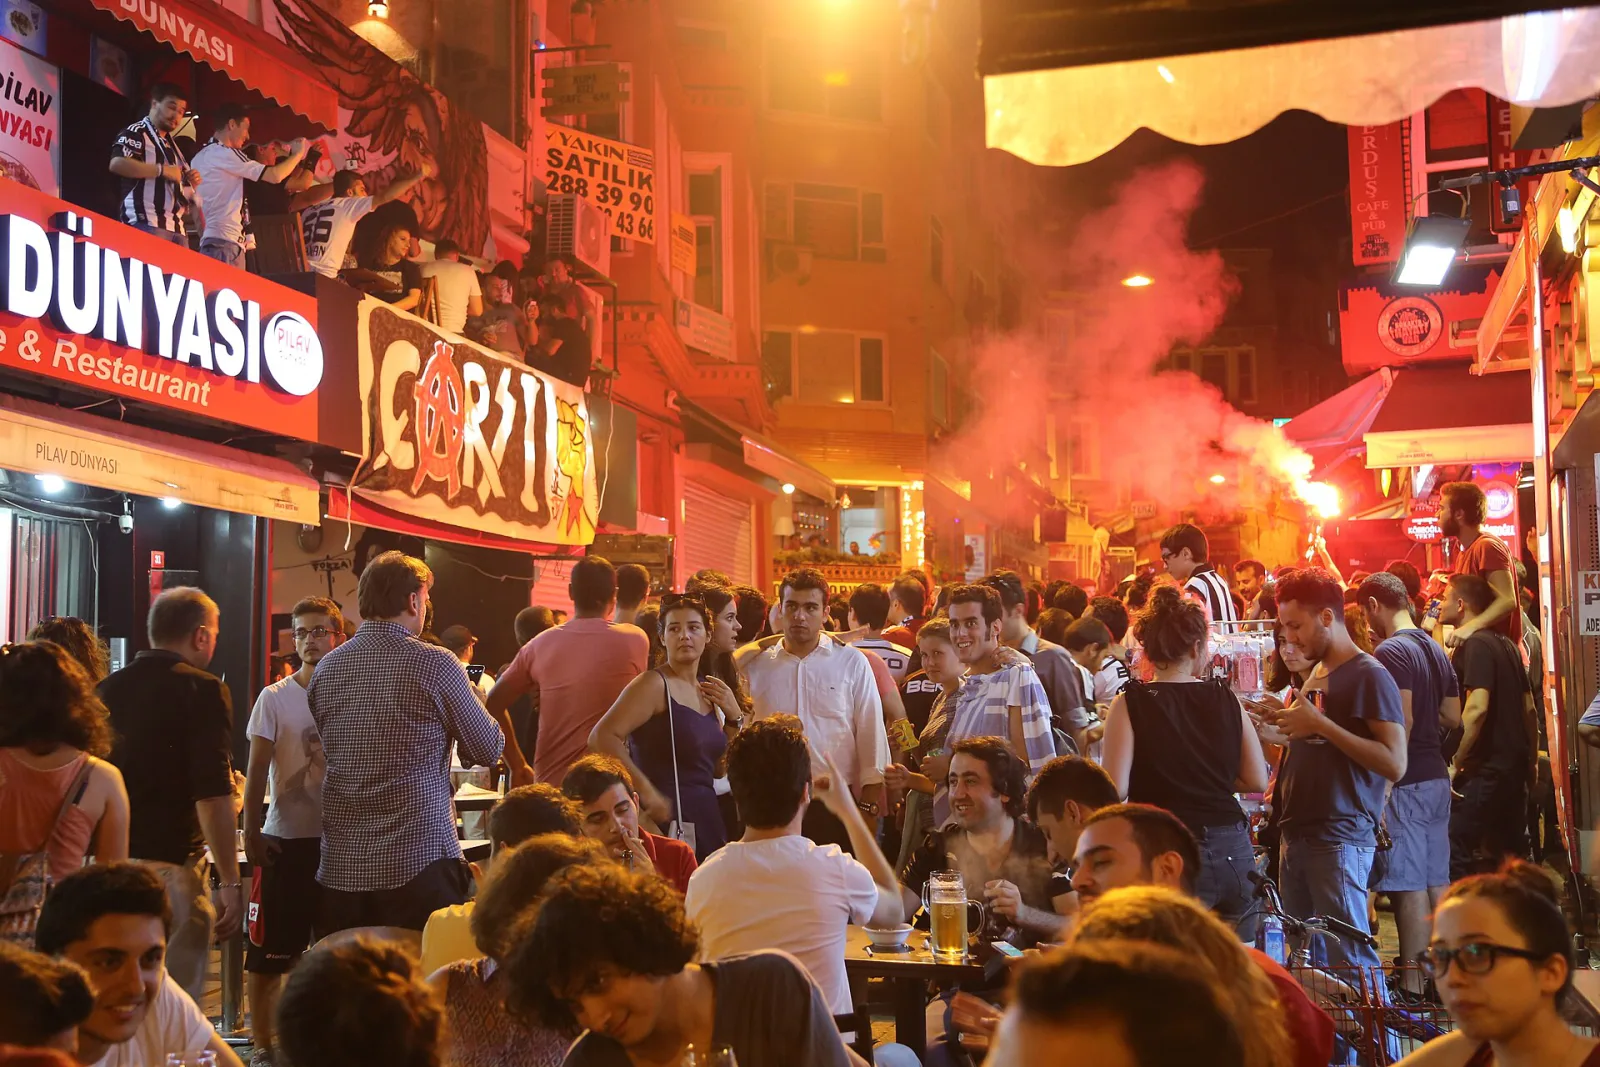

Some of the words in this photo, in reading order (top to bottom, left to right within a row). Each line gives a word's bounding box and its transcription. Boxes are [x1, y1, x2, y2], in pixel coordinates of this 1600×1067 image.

[118, 136, 142, 149] avea
[559, 131, 624, 162] YAKIN
[546, 148, 652, 193] SATILIK
[545, 170, 588, 198] 288
[596, 183, 623, 207] 39
[629, 192, 653, 215] 90
[1356, 201, 1389, 212] CAFE
[616, 212, 634, 235] 43
[638, 217, 653, 240] 66
[1361, 220, 1386, 231] PUB
[1368, 211, 1379, 220] &
[8, 211, 260, 384] DÜNYASI
[18, 329, 42, 363] &
[52, 338, 211, 407] Restaurant
[36, 442, 68, 464] PİLAV
[70, 450, 118, 475] DÜNYASI
